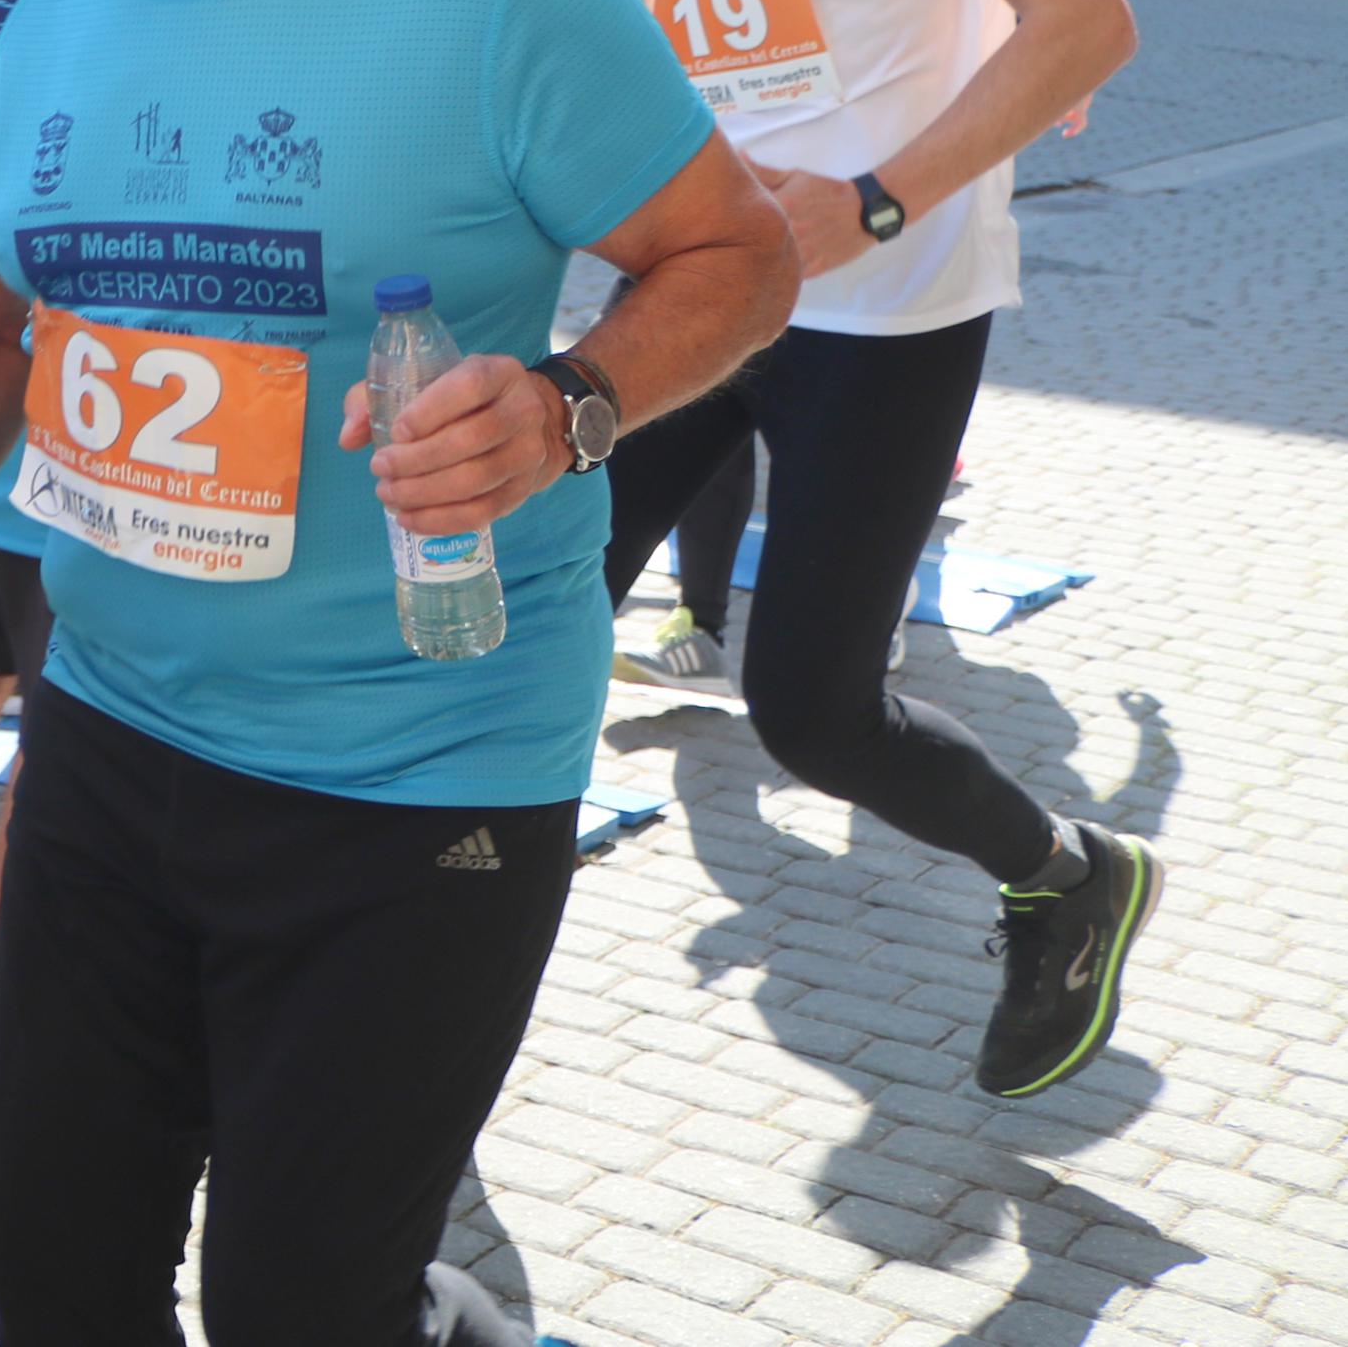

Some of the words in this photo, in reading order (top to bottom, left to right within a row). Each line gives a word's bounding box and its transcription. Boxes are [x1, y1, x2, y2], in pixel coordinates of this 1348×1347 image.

[738, 78, 765, 91] Eres
[767, 66, 822, 85] nuestra
[80, 231, 164, 261] Media
[172, 232, 306, 271] Maratón
[77, 270, 223, 304] CERRATO
[233, 277, 319, 309] 2023
[61, 330, 222, 477] 62
[79, 451, 162, 492] Castellana
[167, 473, 193, 501] del
[199, 479, 282, 510] Cerrato
[132, 508, 170, 536] Eres
[177, 523, 271, 550] nuestra
[153, 541, 243, 571] energía
[435, 854, 502, 870] adidas
